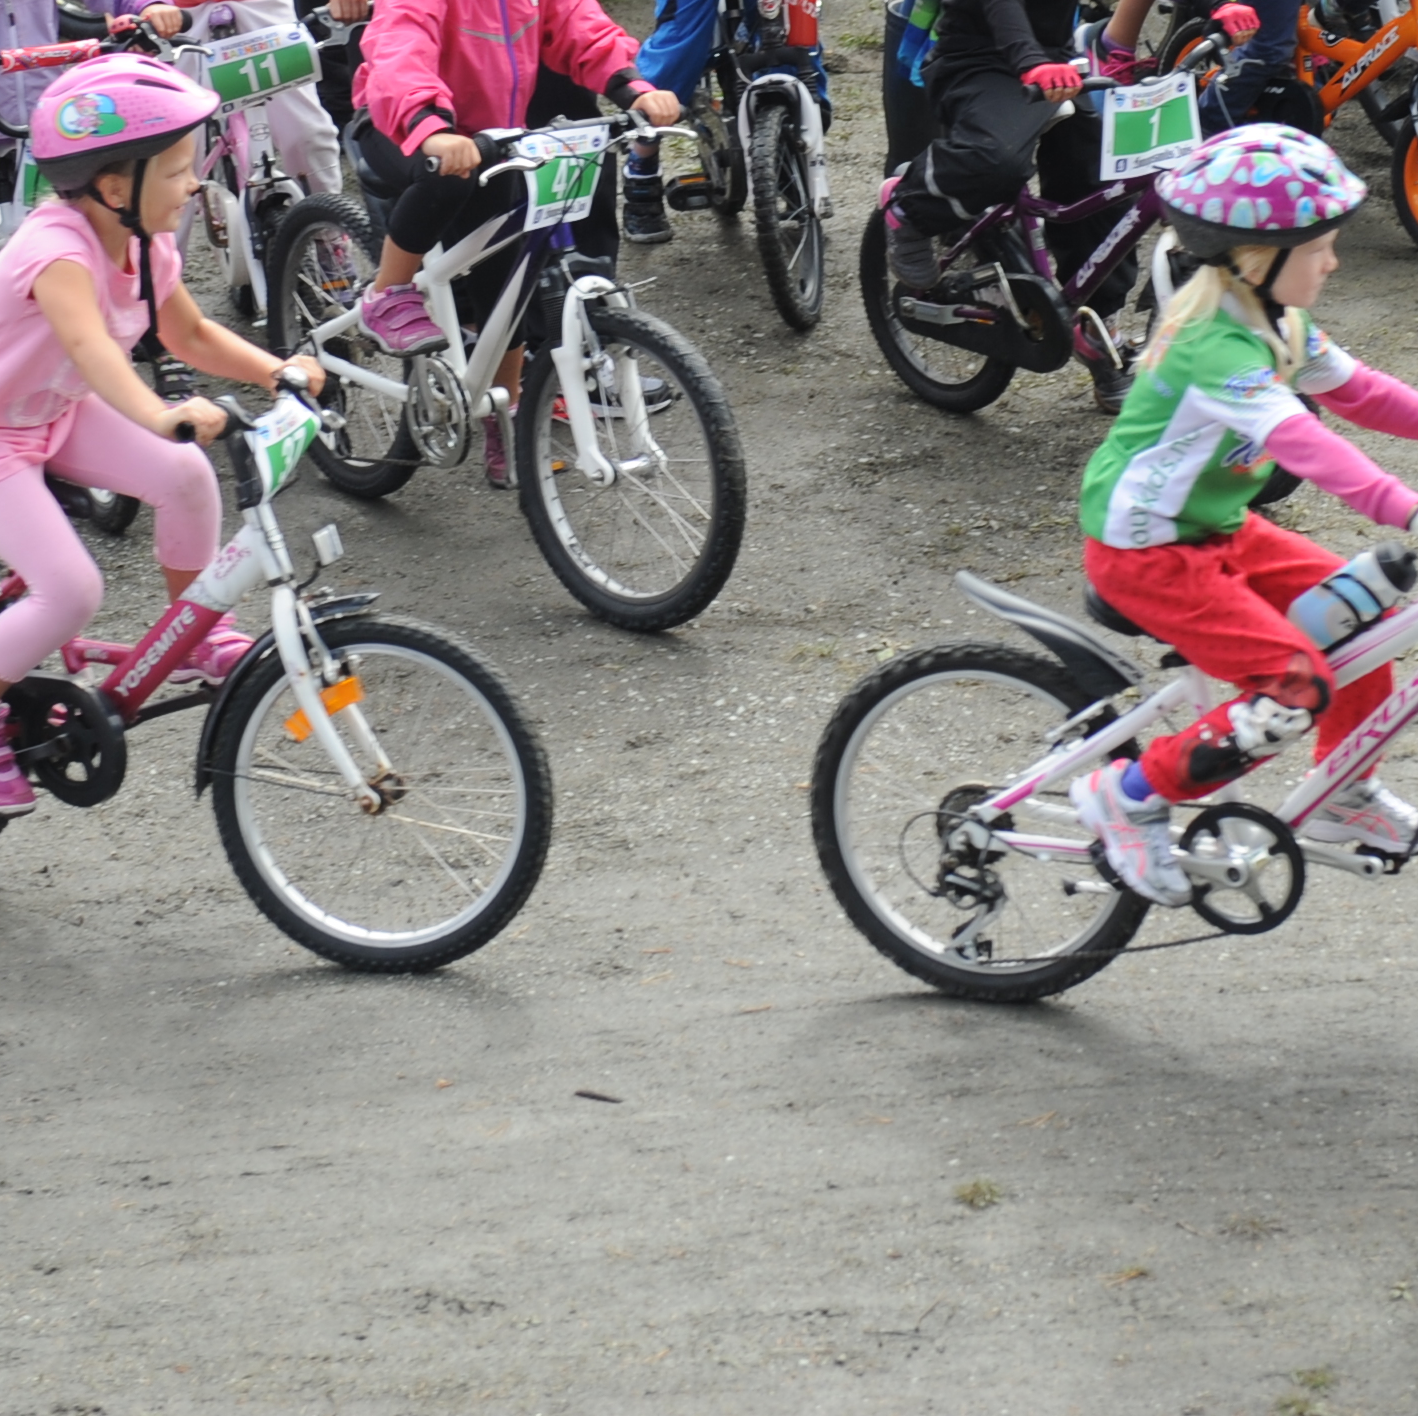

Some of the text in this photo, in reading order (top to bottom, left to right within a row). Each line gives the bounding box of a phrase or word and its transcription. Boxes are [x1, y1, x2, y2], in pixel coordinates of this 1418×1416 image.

[238, 53, 281, 92] 11
[1341, 25, 1400, 89] ALPRACE
[1148, 107, 1162, 148] 1
[551, 157, 586, 200] 47
[114, 605, 197, 697] YOSEMITE
